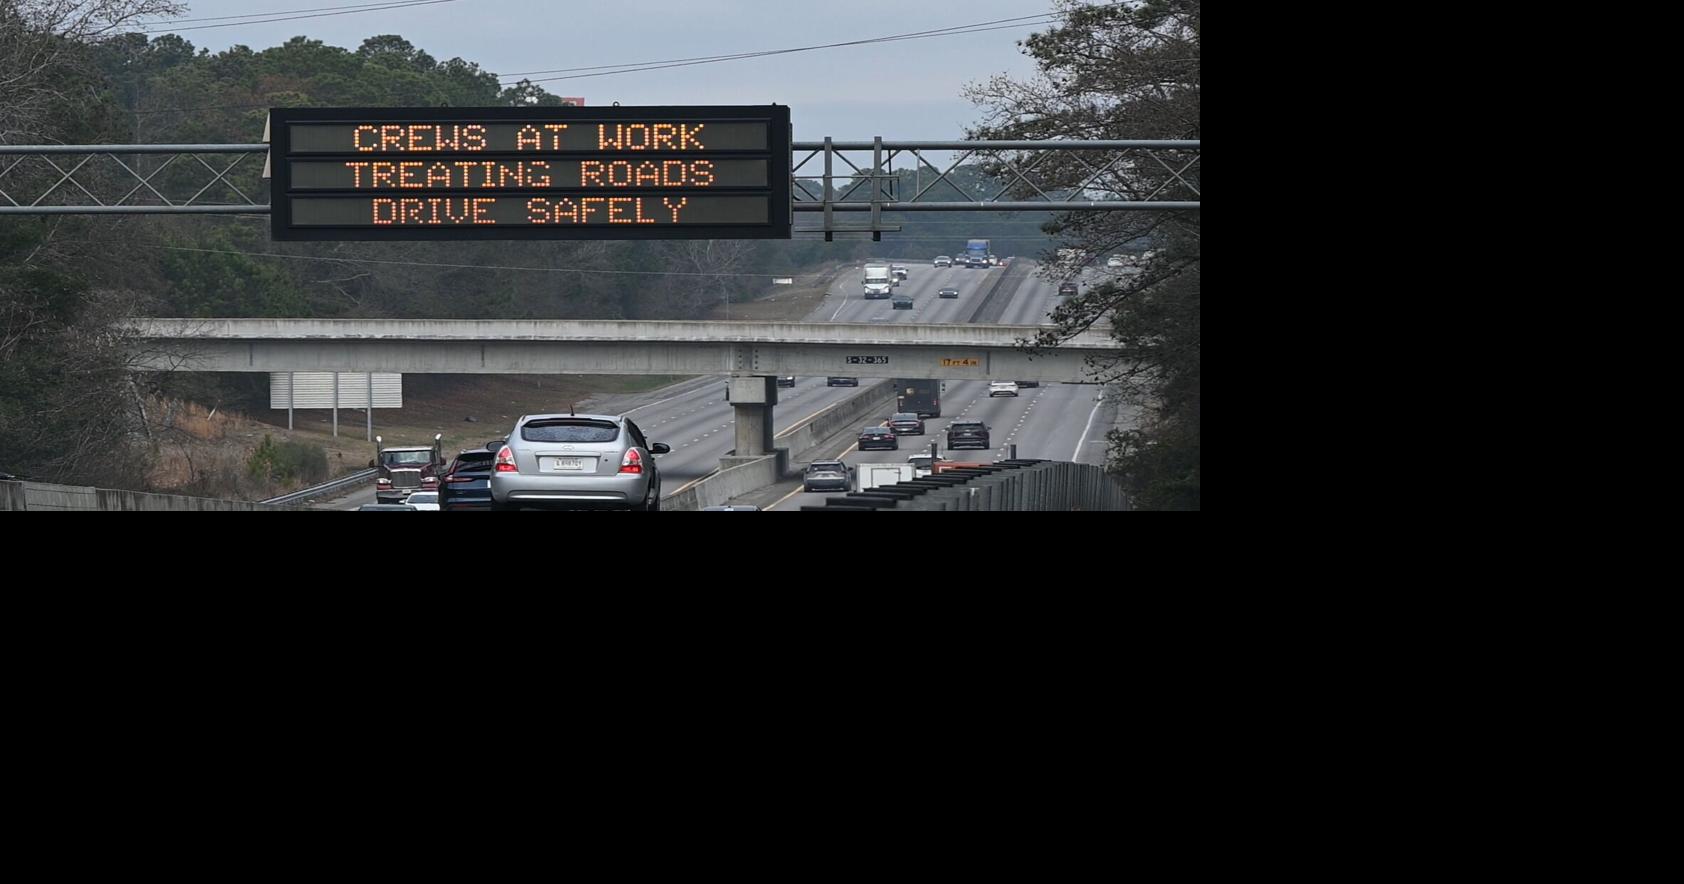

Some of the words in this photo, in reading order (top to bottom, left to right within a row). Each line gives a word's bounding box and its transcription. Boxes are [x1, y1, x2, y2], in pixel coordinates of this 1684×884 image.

[354, 125, 486, 151] CREWS
[518, 123, 569, 151] AT
[598, 123, 704, 151] WORK
[346, 161, 551, 188] TREATING
[581, 160, 714, 187] ROADS
[373, 197, 496, 225] DRIVE
[527, 197, 687, 224] SAFELY
